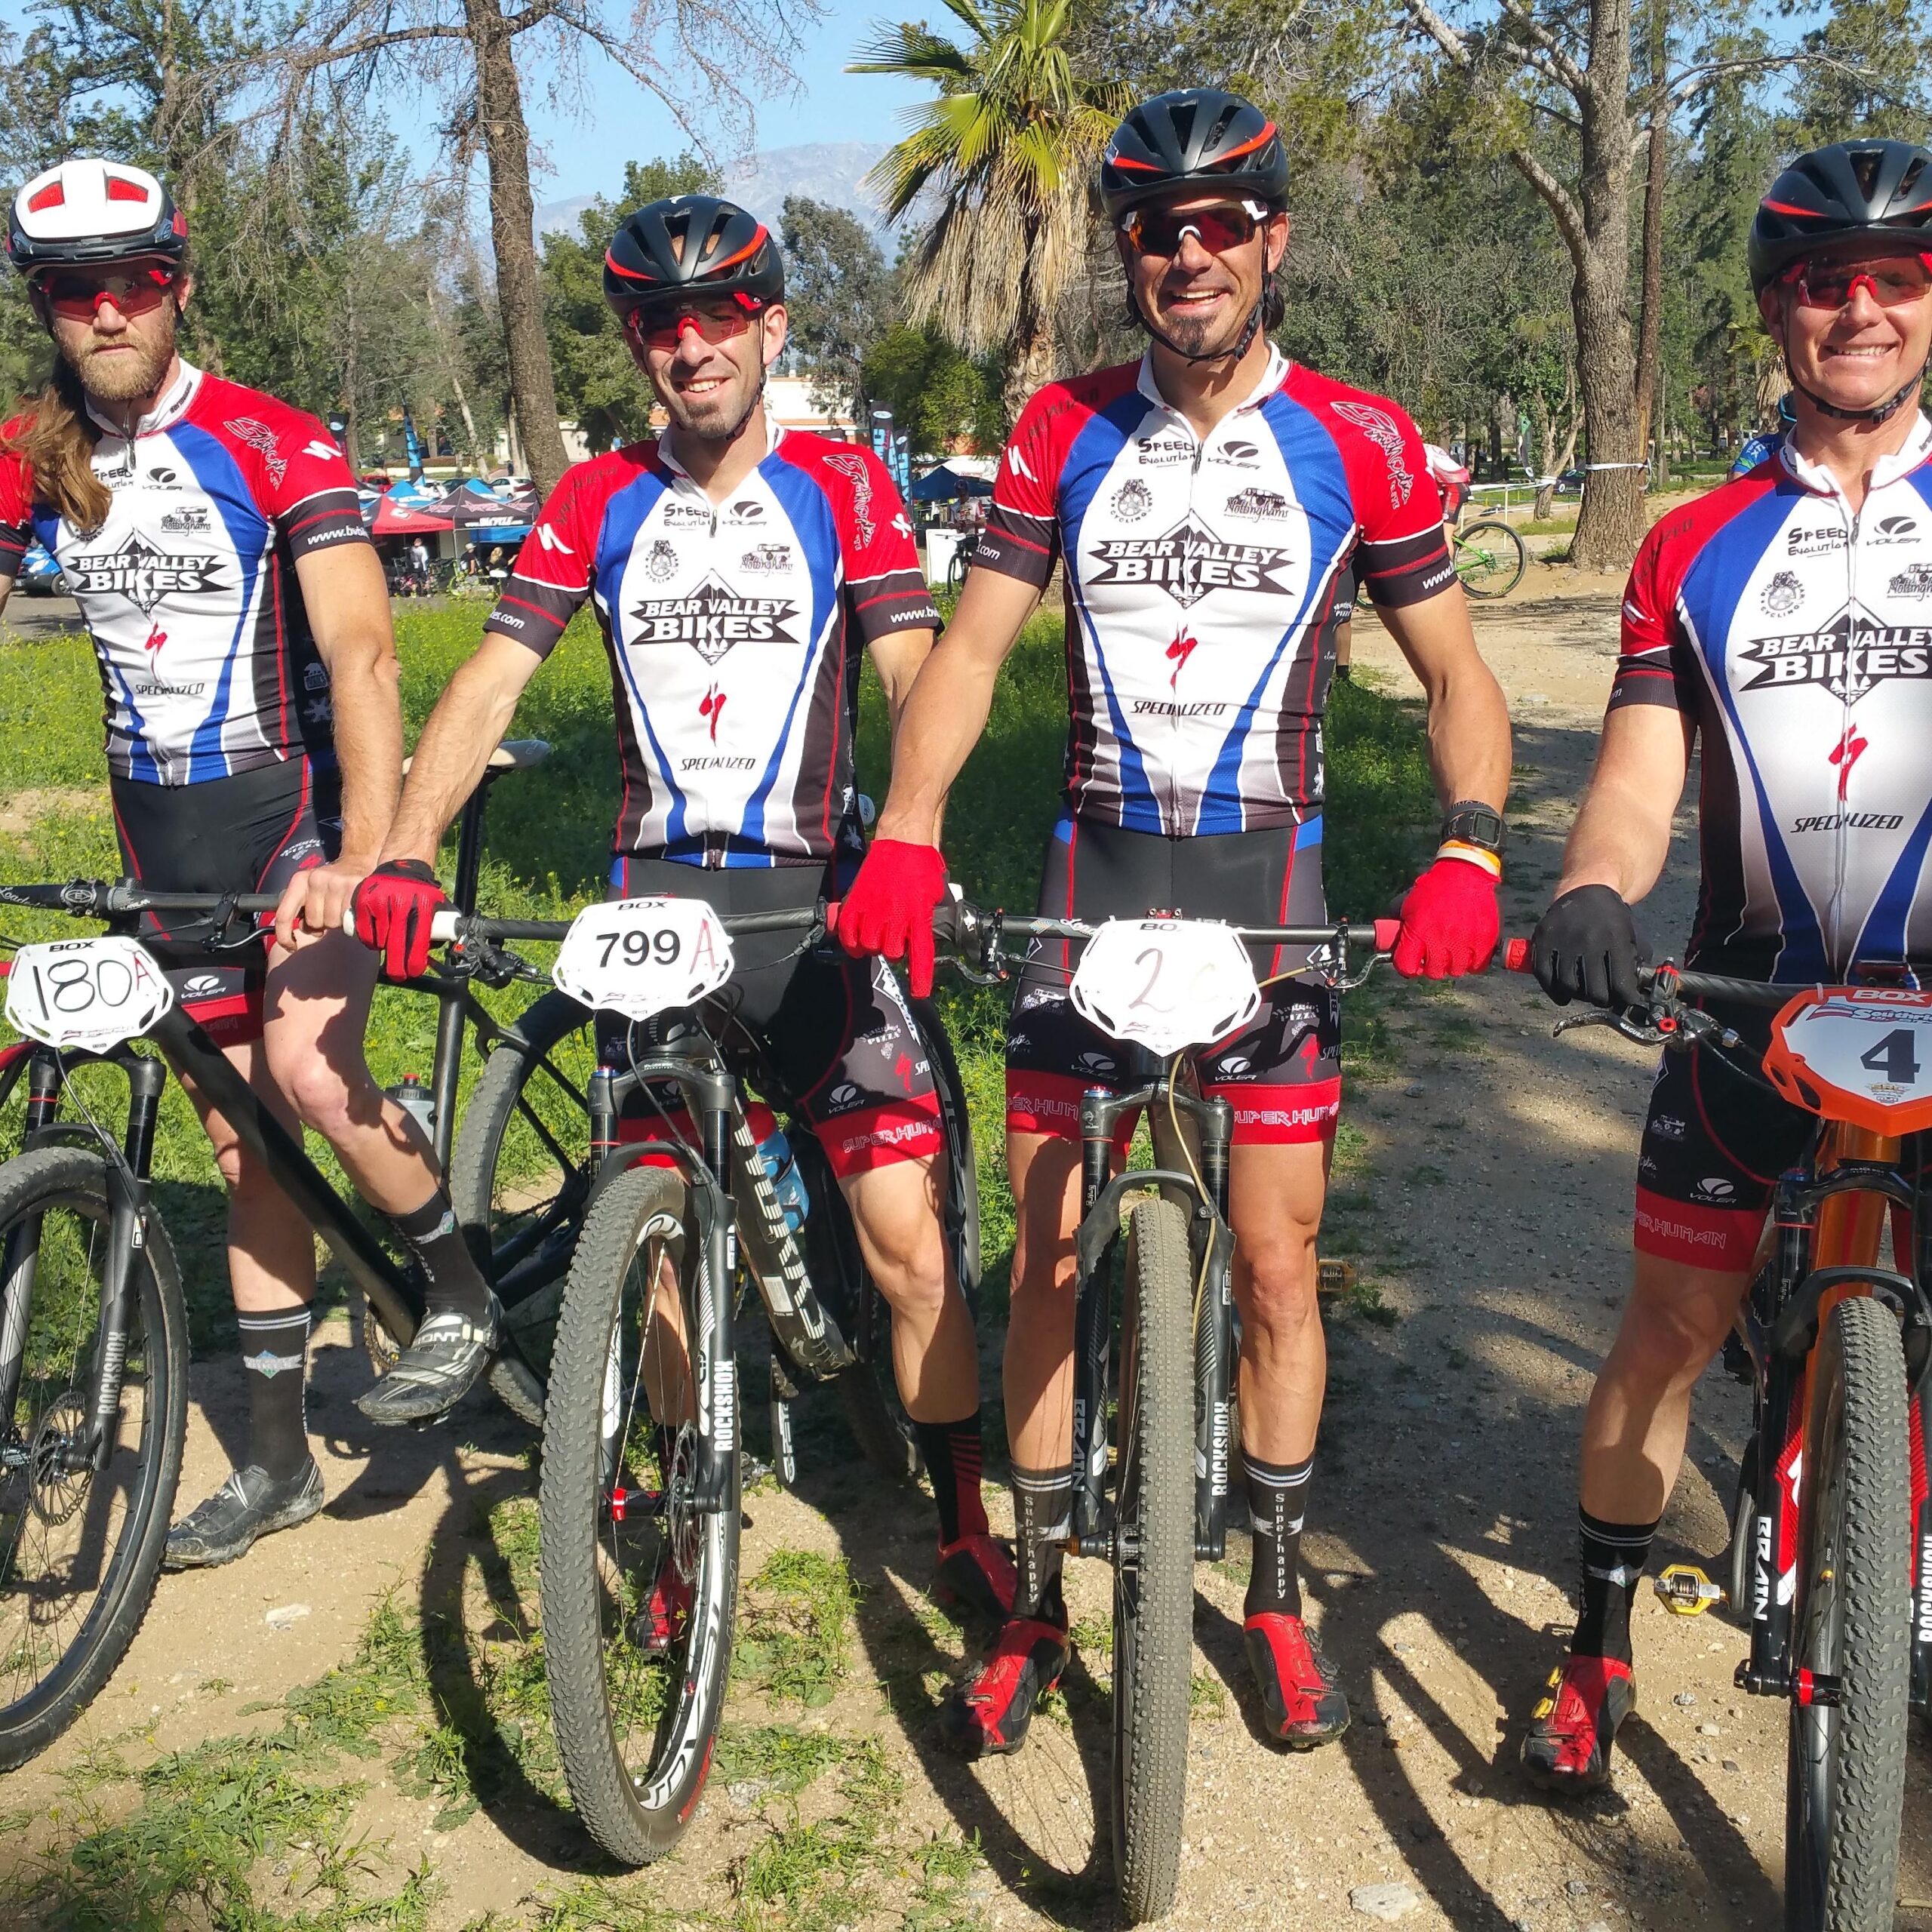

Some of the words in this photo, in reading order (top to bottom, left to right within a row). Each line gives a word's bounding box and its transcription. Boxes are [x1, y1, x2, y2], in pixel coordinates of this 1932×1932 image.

[1137, 438, 1195, 453] SPEED
[1208, 457, 1262, 470] VOLER
[663, 503, 710, 518] SPEED
[1111, 509, 1148, 524] CYCLING
[1223, 497, 1290, 523] Nottinghams
[1788, 527, 1849, 545] SPEED
[1866, 537, 1922, 546] VOLER
[1103, 540, 1177, 558] BEAR
[1178, 540, 1278, 565] VALLEY
[77, 555, 133, 571] BEAR
[132, 555, 212, 571] VALLEY
[78, 569, 202, 592] BIKES
[1097, 558, 1260, 588] BIKES
[641, 598, 702, 617] BEAR
[705, 598, 788, 616] VALLEY
[1760, 605, 1800, 618] CYCLING
[640, 615, 774, 641] BIKES
[1756, 633, 1837, 658] BEAR
[1838, 629, 1932, 651] VALLEY
[1754, 648, 1929, 685] BIKES
[136, 682, 205, 696] SPECIALIZED
[1131, 701, 1227, 718] SPECIALIZED
[679, 757, 756, 771] SPECIALIZED
[1790, 812, 1904, 833] SPECIALIZED
[617, 901, 668, 911] BOX
[1139, 922, 1183, 933] BO
[49, 940, 97, 952] BOX
[596, 929, 681, 968] 799
[688, 918, 716, 974] A
[32, 958, 133, 1021] 180
[180, 986, 227, 999] VOLER
[1852, 989, 1930, 1003] BOX
[1620, 1022, 1645, 1040] MAGURA
[1860, 1029, 1921, 1084] 4
[1070, 1063, 1119, 1081] VOLER
[828, 1099, 866, 1114] VOLER
[1689, 1192, 1737, 1204] VOLER
[417, 1331, 461, 1345] ONT
[97, 1331, 128, 1414] ROCKSHOX
[713, 1360, 734, 1451] ROCKSHOX
[1072, 1398, 1086, 1491] BRAIN
[1211, 1401, 1229, 1497] ROCKSHOX
[1024, 1495, 1038, 1605] Superhappy
[1275, 1493, 1286, 1600] Superhappy
[1752, 1515, 1773, 1621] BRAIN
